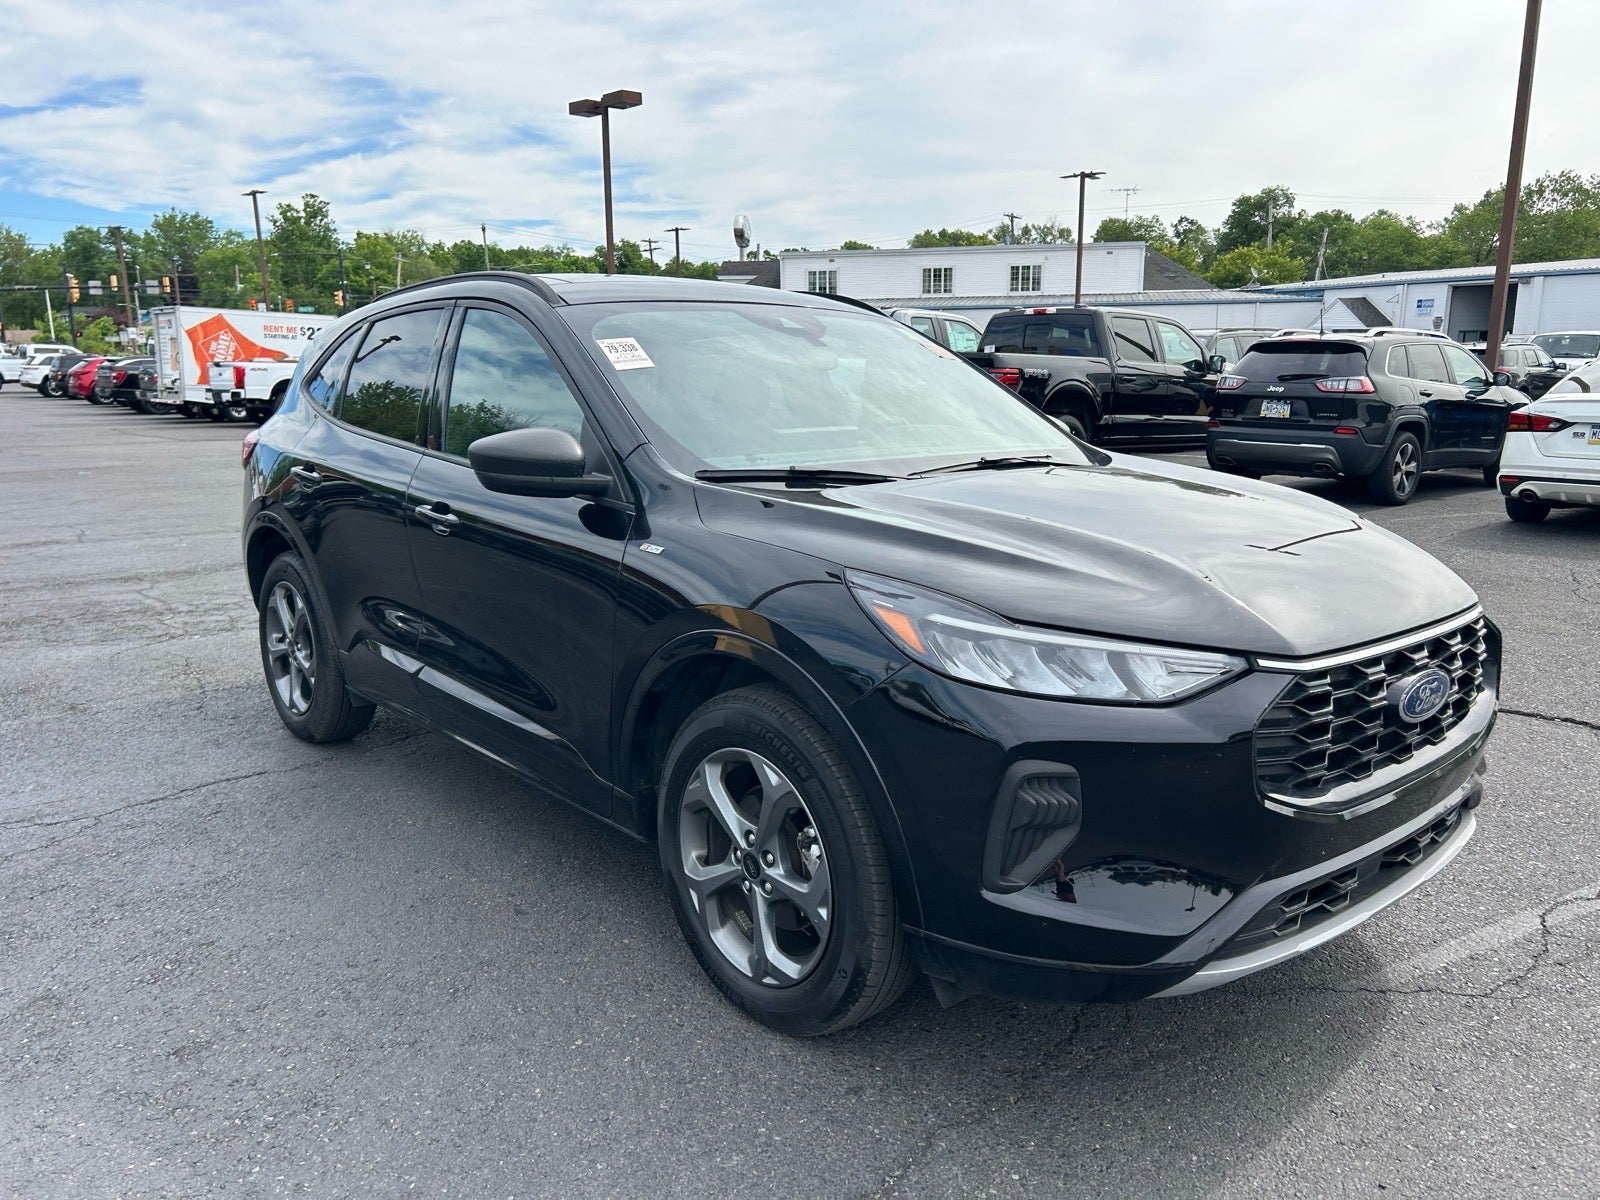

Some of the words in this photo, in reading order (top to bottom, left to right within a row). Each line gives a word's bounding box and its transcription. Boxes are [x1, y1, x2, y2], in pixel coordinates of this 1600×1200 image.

[286, 326, 298, 334] ME
[208, 340, 218, 354] THE
[1415, 681, 1443, 713] Ford
[749, 721, 811, 781] MICHELIN
